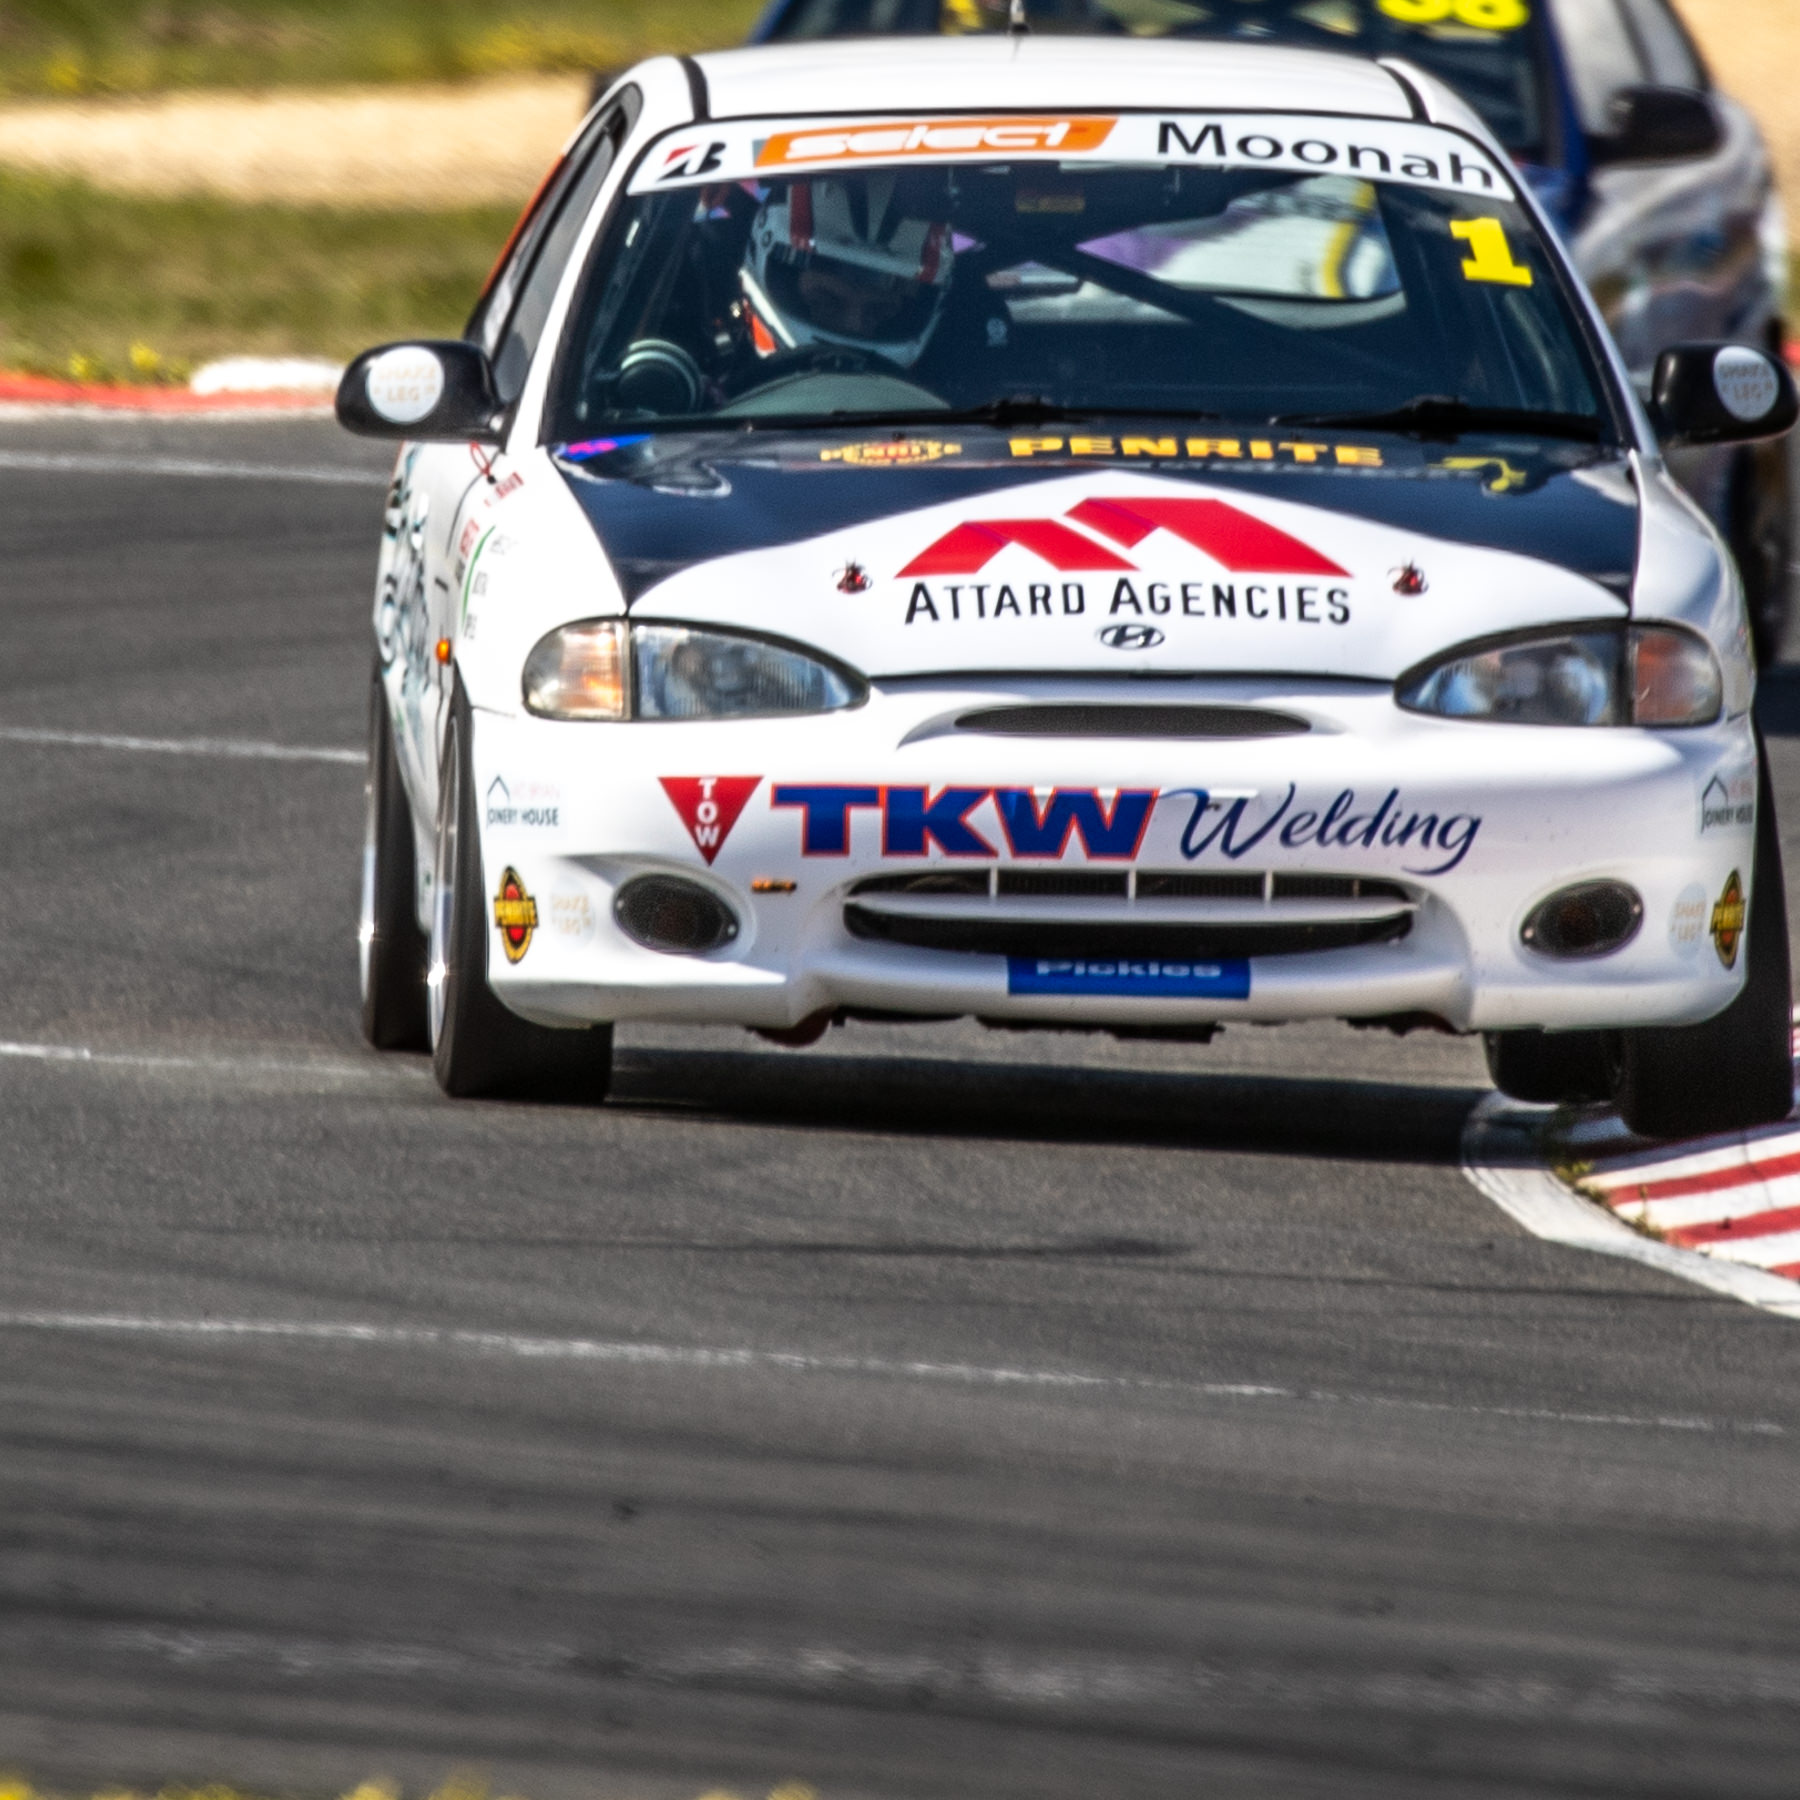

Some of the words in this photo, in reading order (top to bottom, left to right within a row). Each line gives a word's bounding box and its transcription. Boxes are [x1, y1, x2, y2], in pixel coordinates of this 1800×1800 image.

[1155, 120, 1496, 190] Moonah
[1449, 217, 1534, 287] 1
[1008, 436, 1384, 468] PENRITE
[904, 582, 1086, 625] ATTARD
[1108, 577, 1352, 625] AGENCIES
[695, 777, 721, 847] TOW
[769, 782, 1161, 862] TKW
[1156, 781, 1482, 877] Welding
[1036, 960, 1222, 978] Pickles
